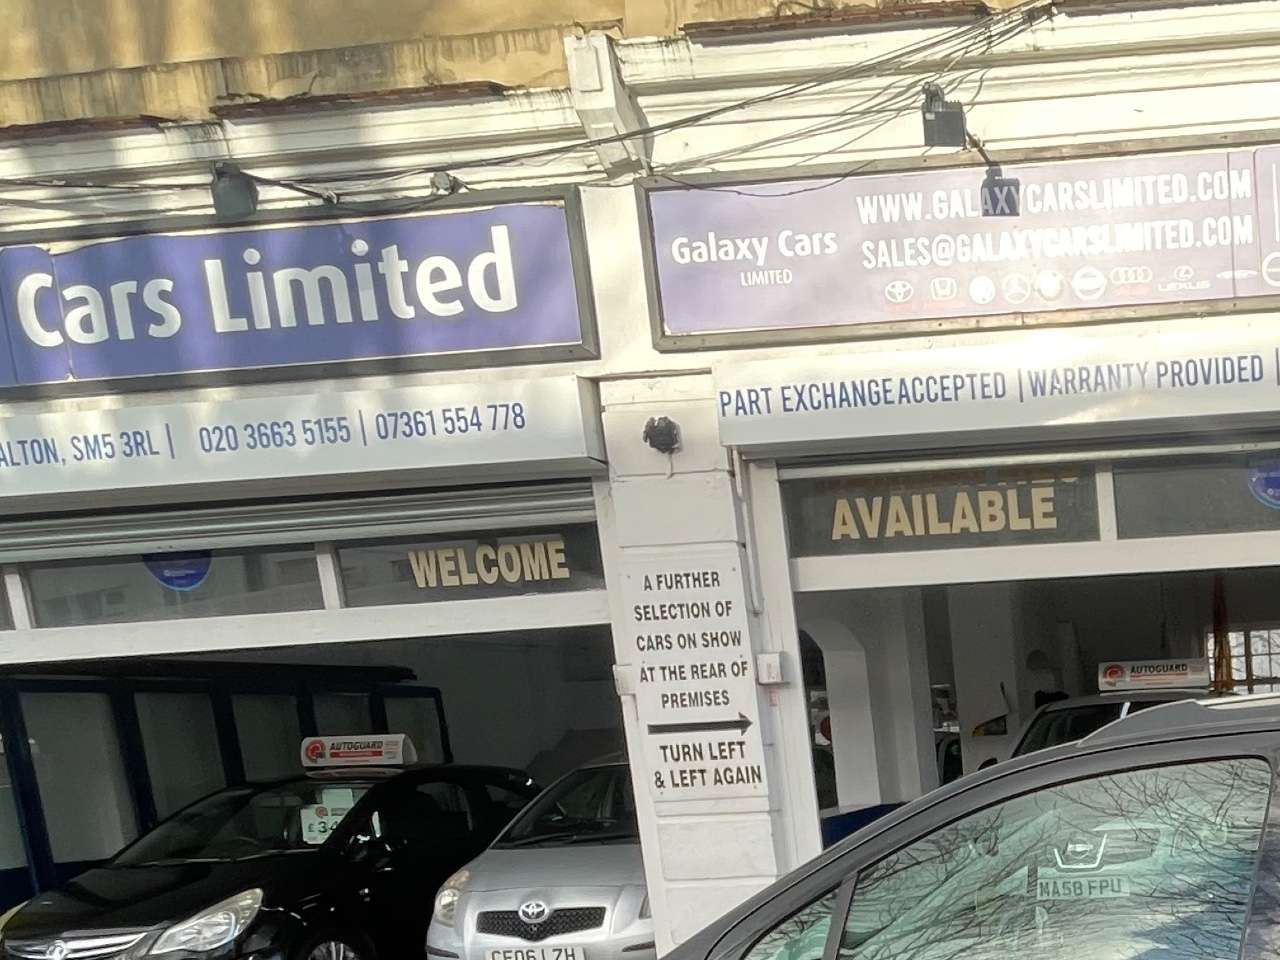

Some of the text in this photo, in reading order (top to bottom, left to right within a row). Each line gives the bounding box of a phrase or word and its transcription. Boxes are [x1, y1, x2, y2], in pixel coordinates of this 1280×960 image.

[856, 168, 1252, 225] WWW.GALAXYCARSLIMITED.COM
[671, 230, 838, 266] Galaxy Cars
[861, 214, 1254, 270] SALES@GALAXYCARSLIMITED.COM
[15, 224, 518, 347] Cars Limited
[740, 268, 792, 287] LIMITED
[719, 387, 773, 417] PART
[780, 378, 893, 413] EXCHANGE
[898, 372, 1006, 404] ACCEPTED
[1027, 360, 1150, 398] WARRANTY
[1156, 354, 1264, 388] PROVIDED
[71, 432, 116, 462] SM5
[119, 429, 160, 458] 3RL
[200, 424, 239, 453] 020
[243, 420, 297, 450] 3663
[301, 416, 351, 446] 5155
[375, 409, 437, 440] 07361
[442, 405, 482, 435] 554
[486, 402, 527, 431] 778
[831, 486, 1058, 541] AVAILABLE
[407, 540, 571, 588] WELCOME
[643, 571, 721, 592] A FURTHER
[633, 600, 733, 622] SELECTION OF
[636, 630, 742, 652] CARS ON SHOW
[640, 660, 748, 683] AT THE REAR OF
[1130, 664, 1188, 674] AUTOGUARD
[661, 690, 730, 709] PREMISES
[330, 741, 383, 751] AUTOGUARD
[659, 740, 746, 763] TURN LEFT
[654, 765, 763, 790] & LEFT AGAIN
